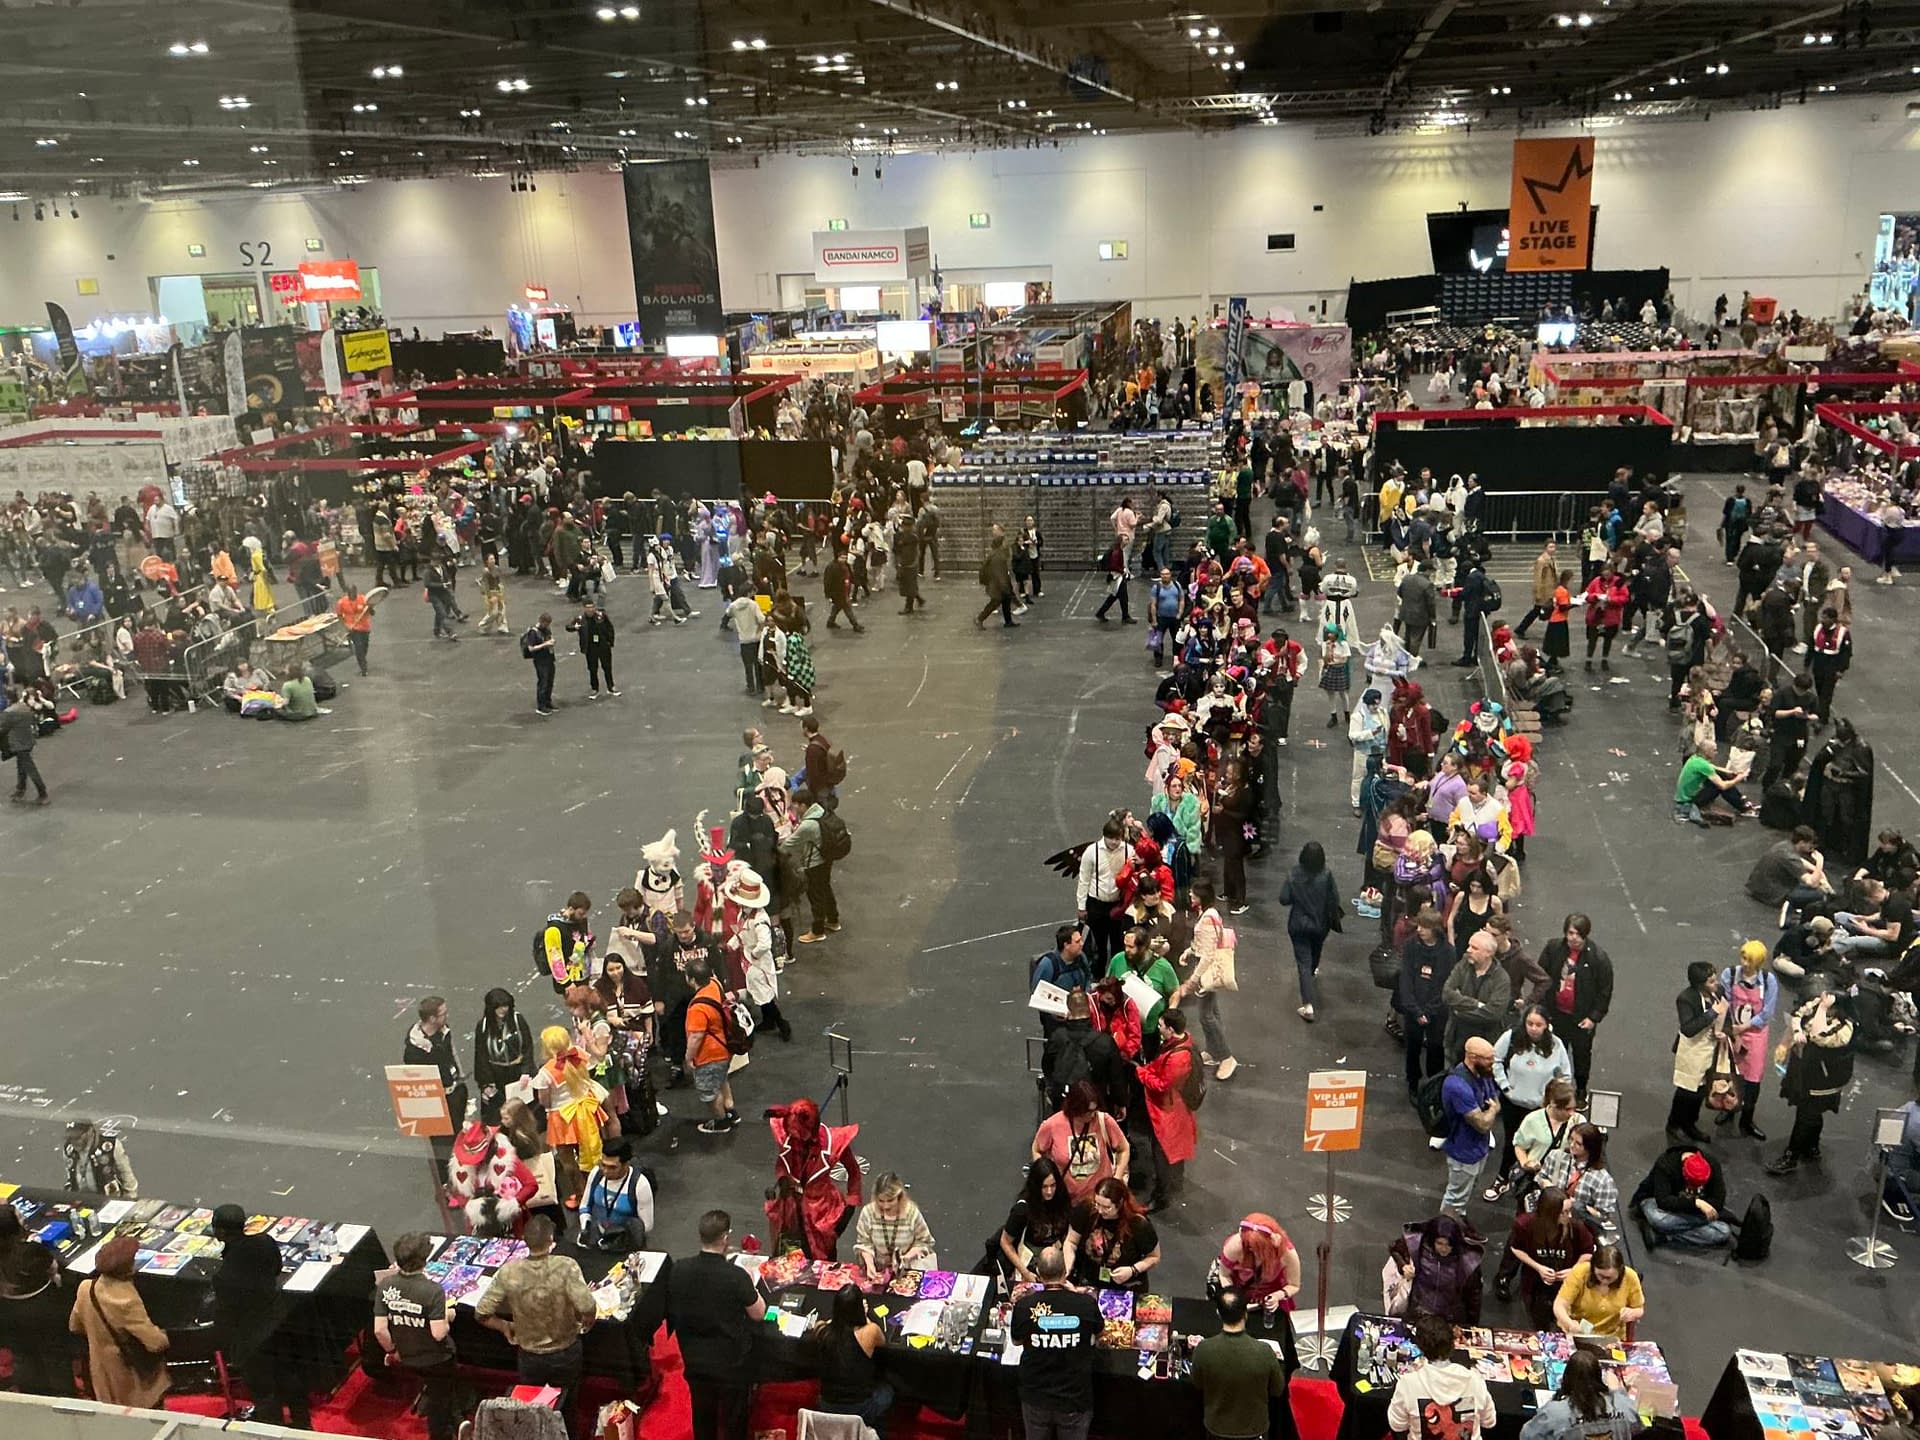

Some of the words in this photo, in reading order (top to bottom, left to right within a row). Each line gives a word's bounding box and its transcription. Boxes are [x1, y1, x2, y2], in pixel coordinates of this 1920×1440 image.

[1529, 220, 1569, 234] LIVE
[1520, 235, 1577, 250] STAGE
[239, 241, 274, 267] S2
[827, 251, 860, 260] BANDAI
[861, 250, 894, 259] NAMCO
[643, 294, 714, 304] BADLANDS
[1226, 302, 1245, 377] Funko
[1314, 1093, 1332, 1101] VIP
[1332, 1092, 1358, 1100] LANE
[1030, 1333, 1080, 1348] STAFF
